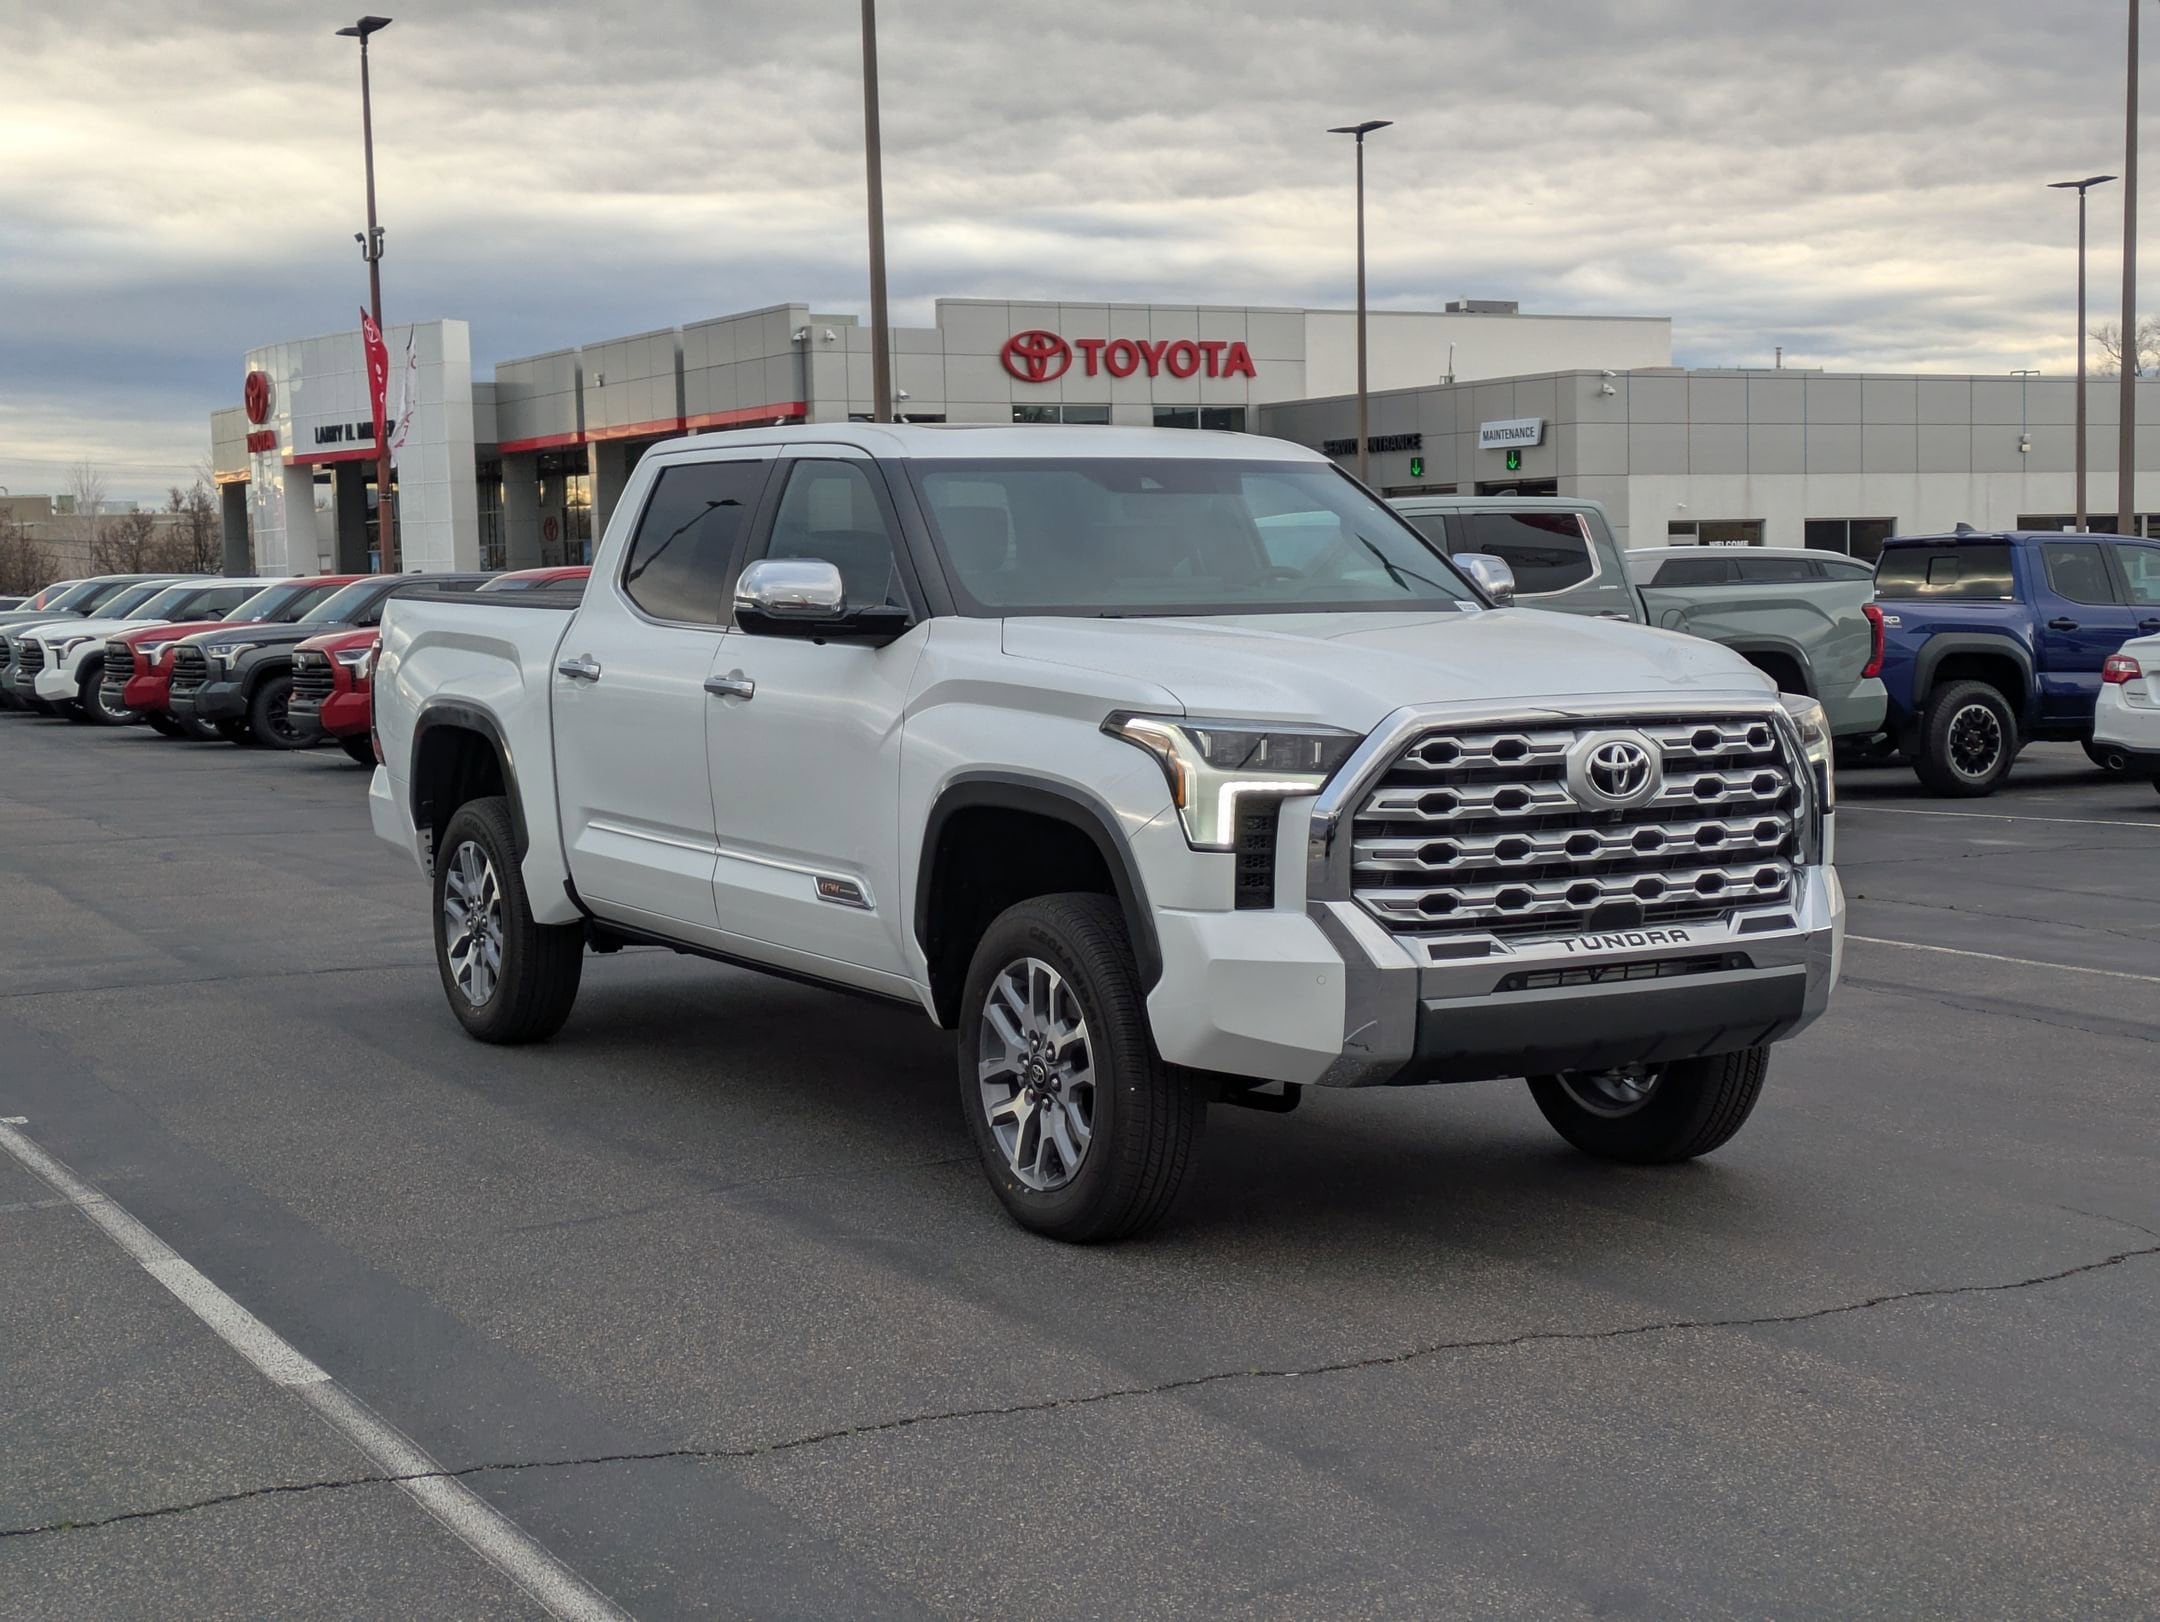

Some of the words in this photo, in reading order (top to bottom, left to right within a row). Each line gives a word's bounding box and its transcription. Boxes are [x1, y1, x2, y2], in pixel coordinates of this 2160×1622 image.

[1076, 338, 1257, 378] TOYOTA
[357, 420, 396, 440] MILR
[1482, 426, 1536, 442] MAINTENANCE
[1323, 438, 1359, 456] SERVIC
[1367, 433, 1423, 454] NTRANCE
[1557, 929, 1690, 952] TUNDRA
